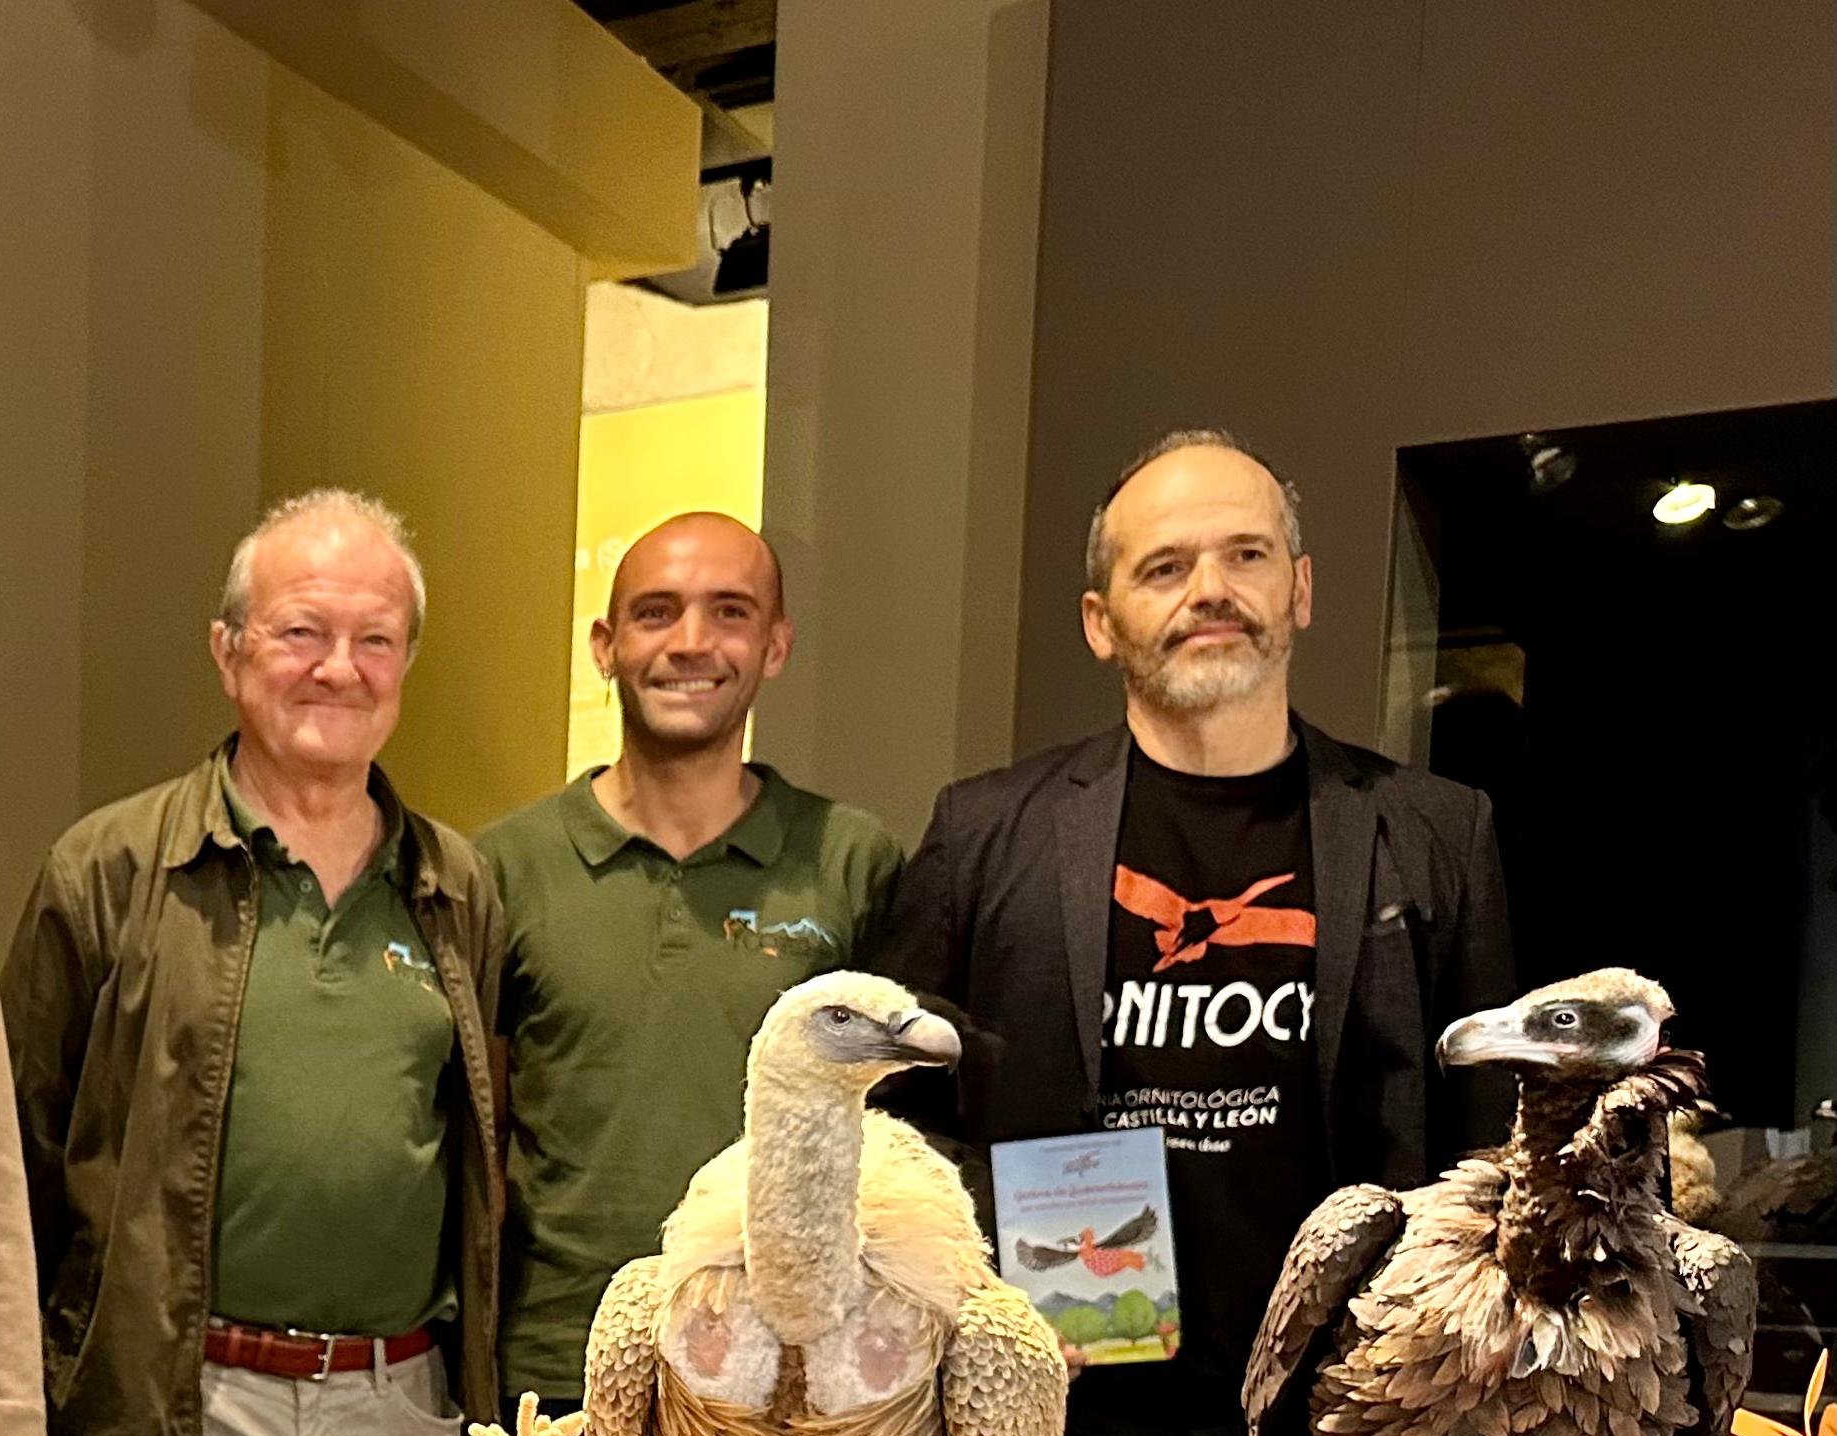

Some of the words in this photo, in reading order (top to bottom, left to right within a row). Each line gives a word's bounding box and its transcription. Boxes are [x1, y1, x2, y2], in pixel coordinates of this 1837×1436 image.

[1124, 1086, 1281, 1110] ORNITOLÓGICA
[1103, 1107, 1191, 1129] CASTILLA
[1194, 1110, 1209, 1130] Y
[1213, 1105, 1278, 1129] LEÓN
